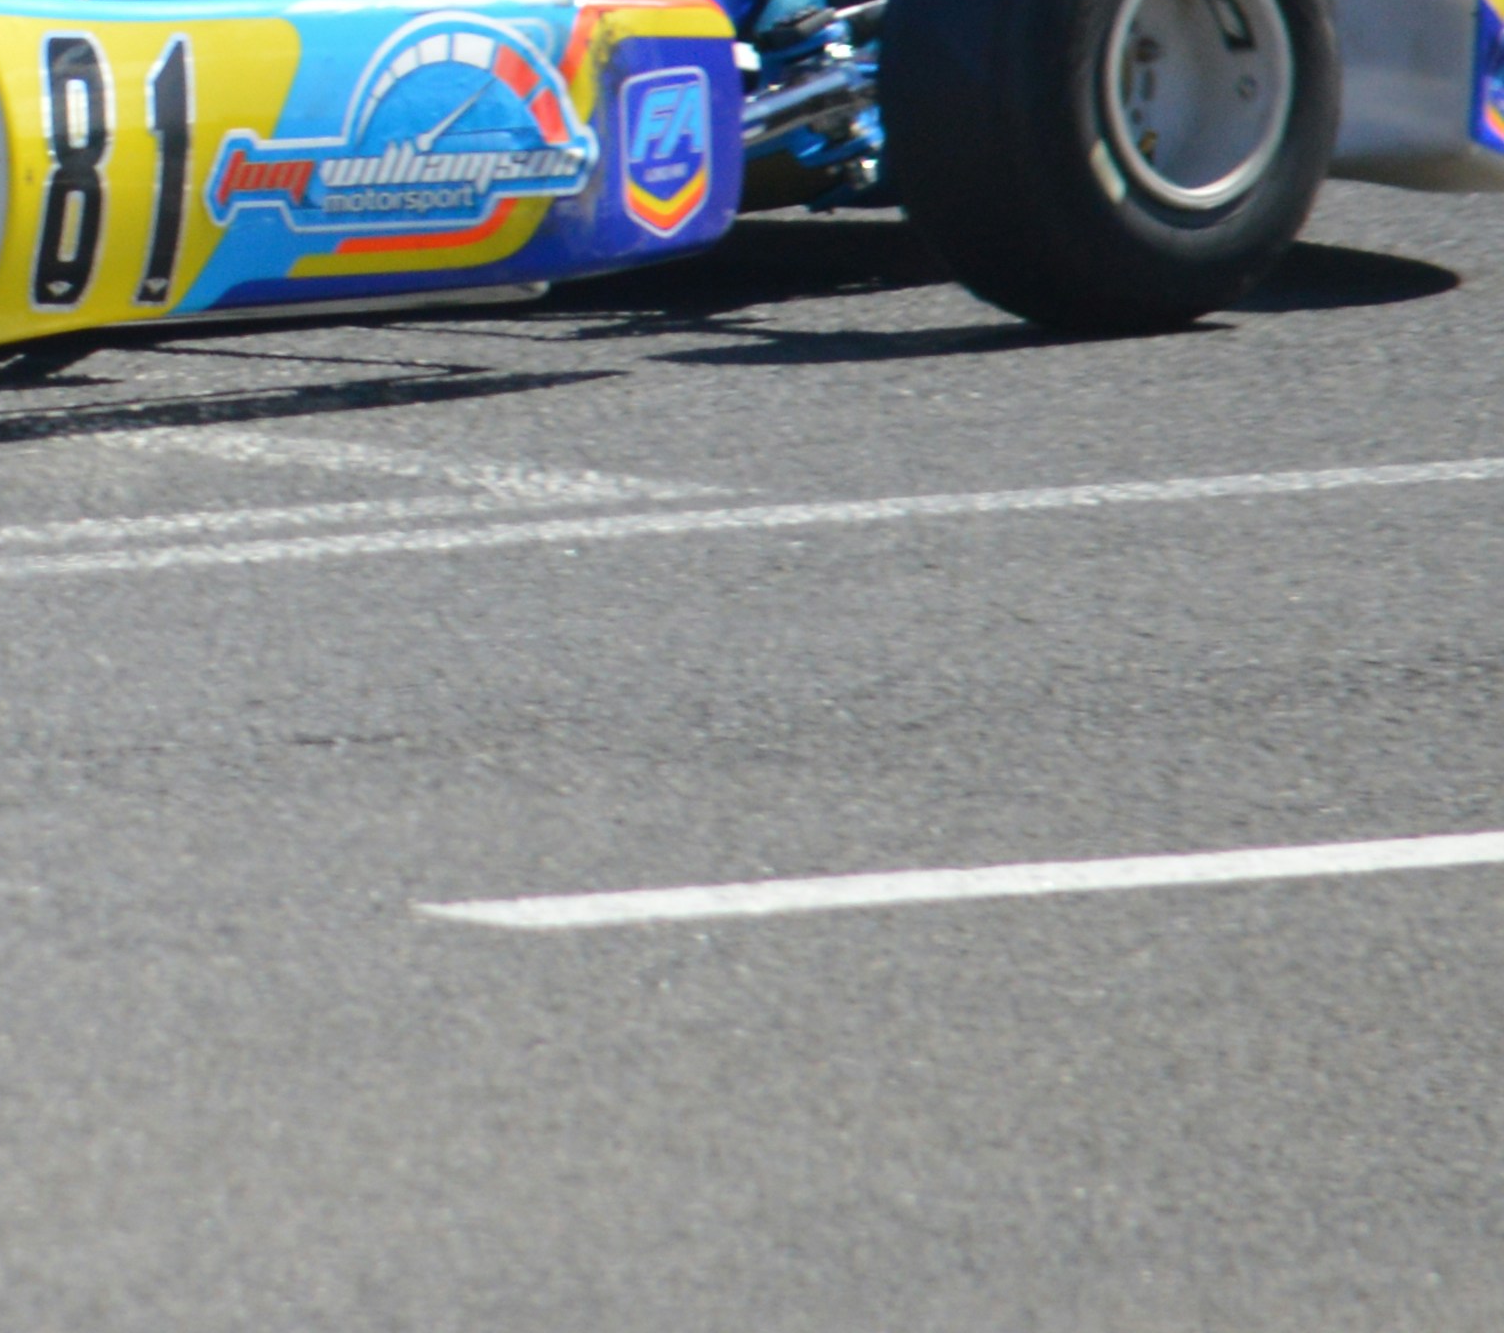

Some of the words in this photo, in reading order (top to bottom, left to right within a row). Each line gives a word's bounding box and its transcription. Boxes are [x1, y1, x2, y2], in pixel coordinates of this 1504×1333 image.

[629, 82, 705, 163] FA
[31, 32, 194, 311] 81
[323, 182, 475, 214] motorsport
